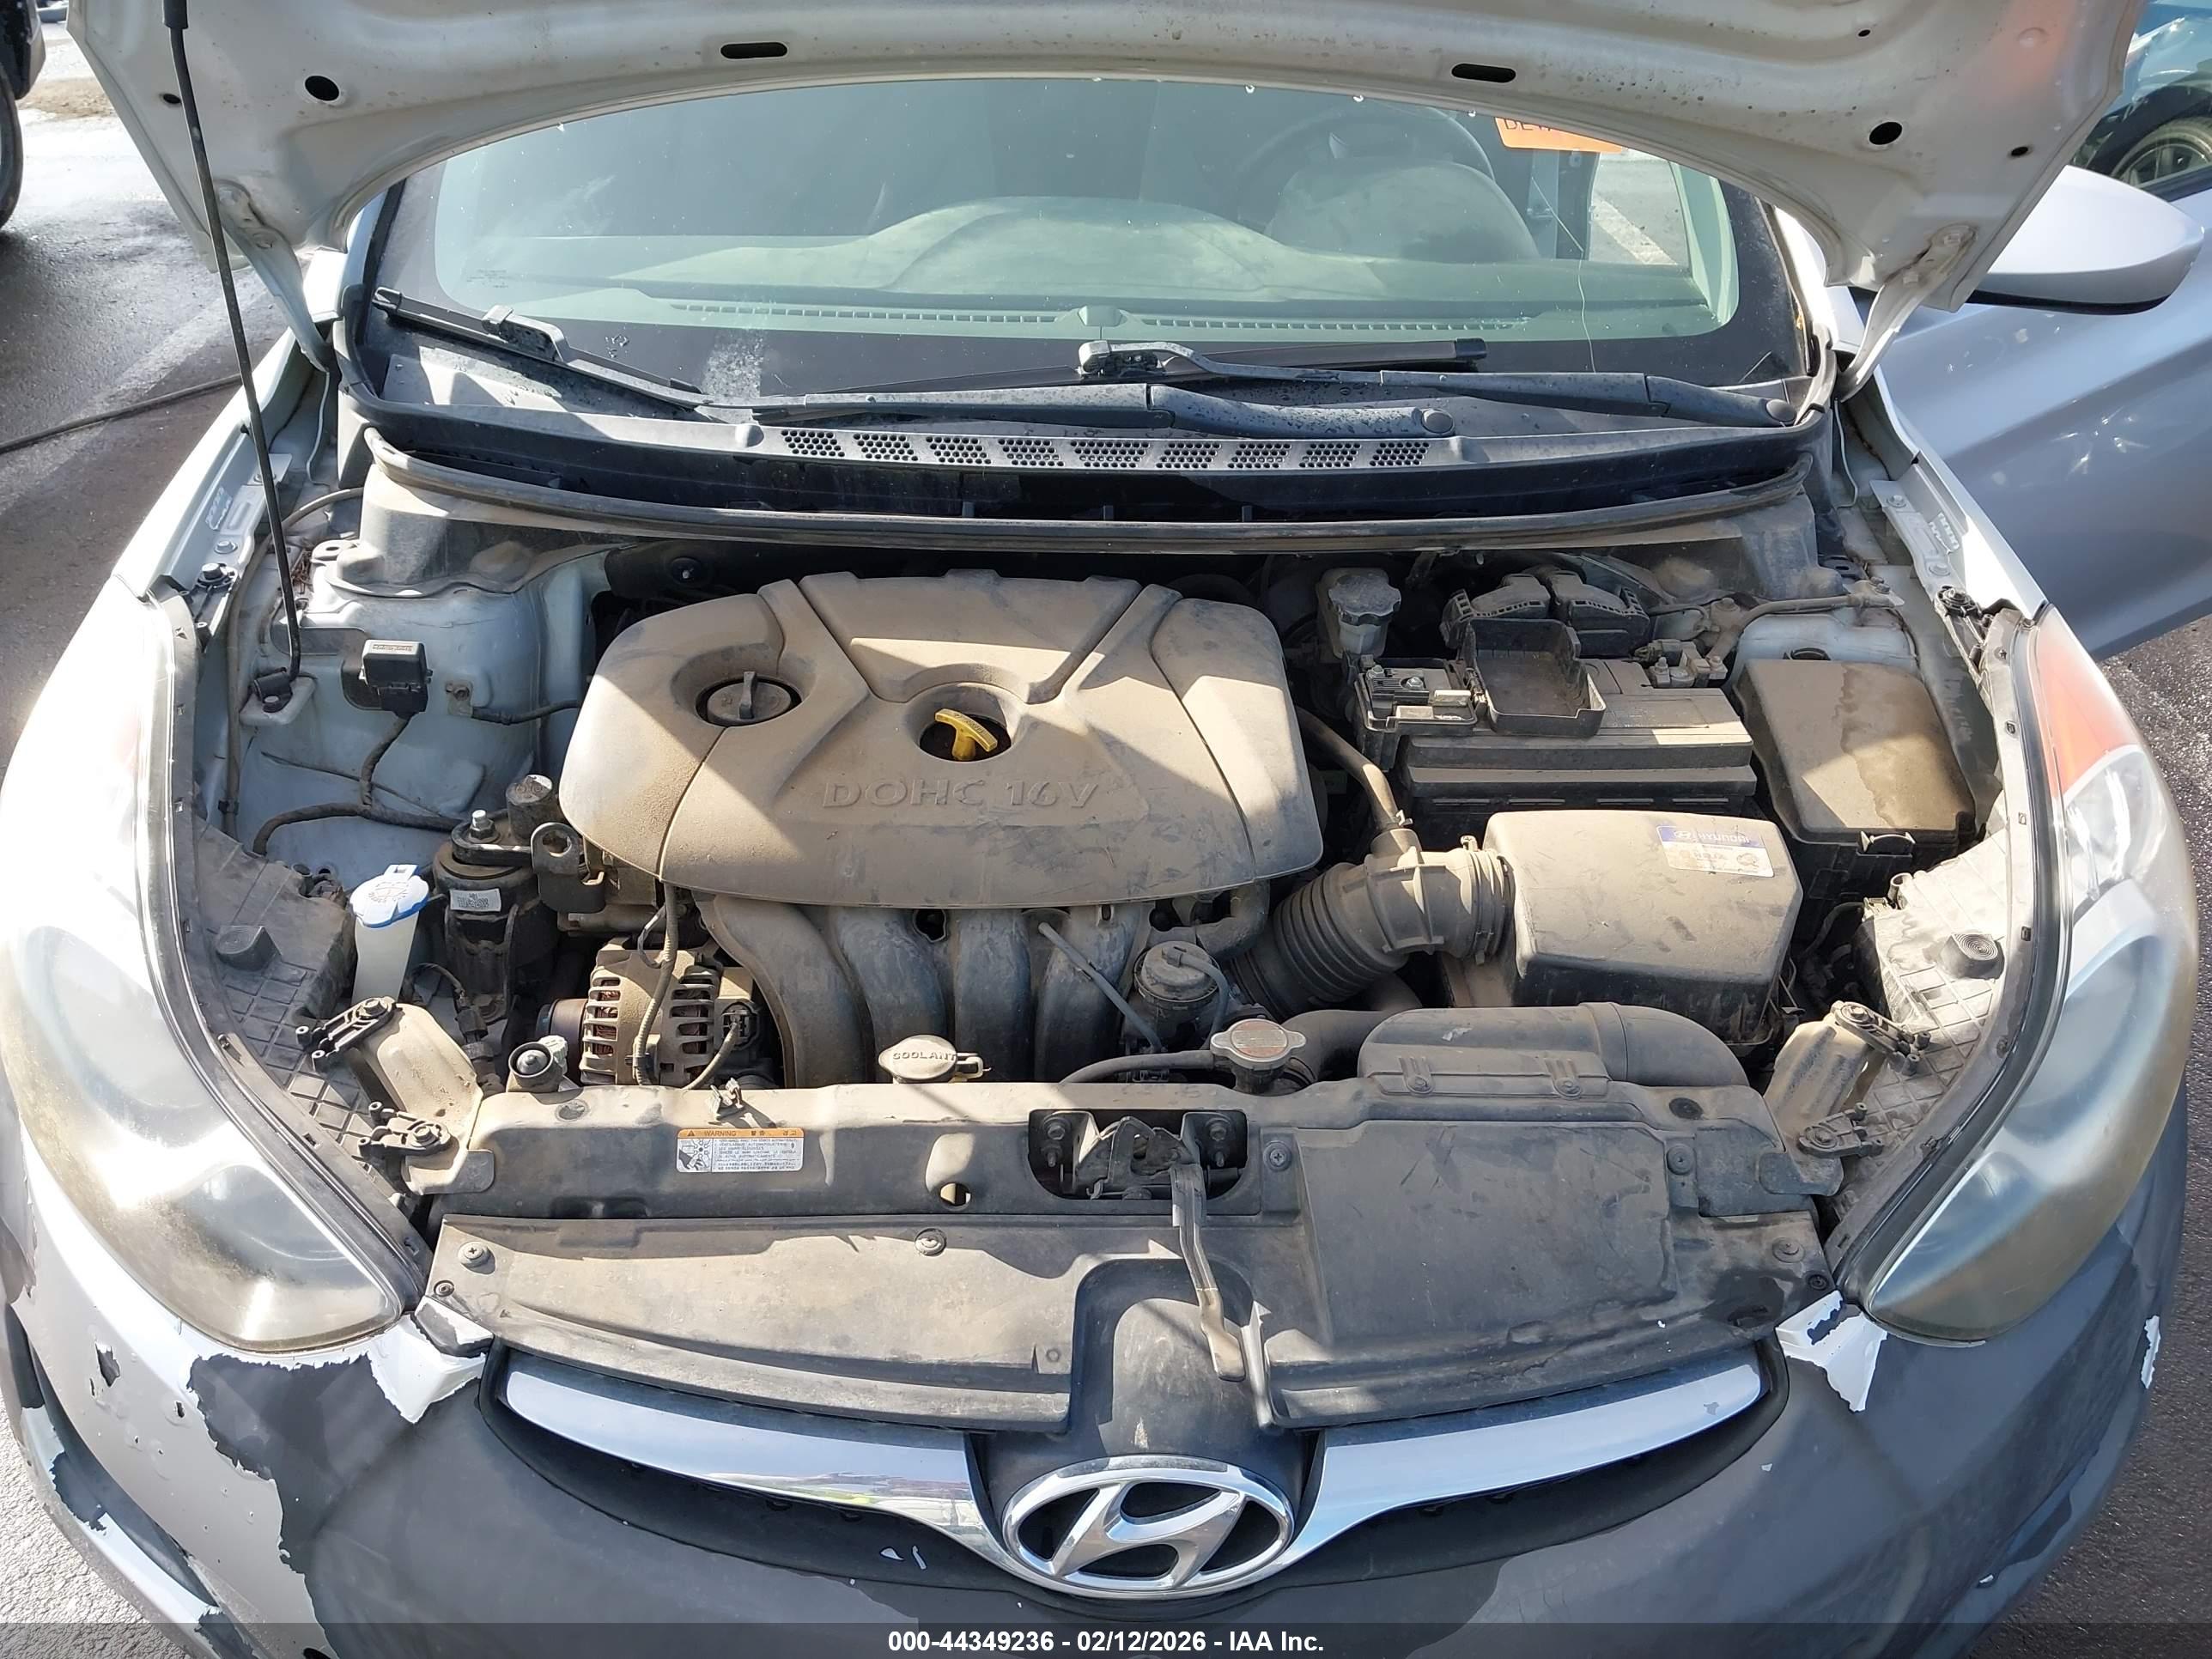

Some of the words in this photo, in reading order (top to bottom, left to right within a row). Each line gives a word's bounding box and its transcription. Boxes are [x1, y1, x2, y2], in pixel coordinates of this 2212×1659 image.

[821, 778, 985, 808] DOHC
[1005, 779, 1098, 809] 16V
[1697, 830, 1751, 844] HYUNDAI
[892, 1052, 957, 1061] COOLANT
